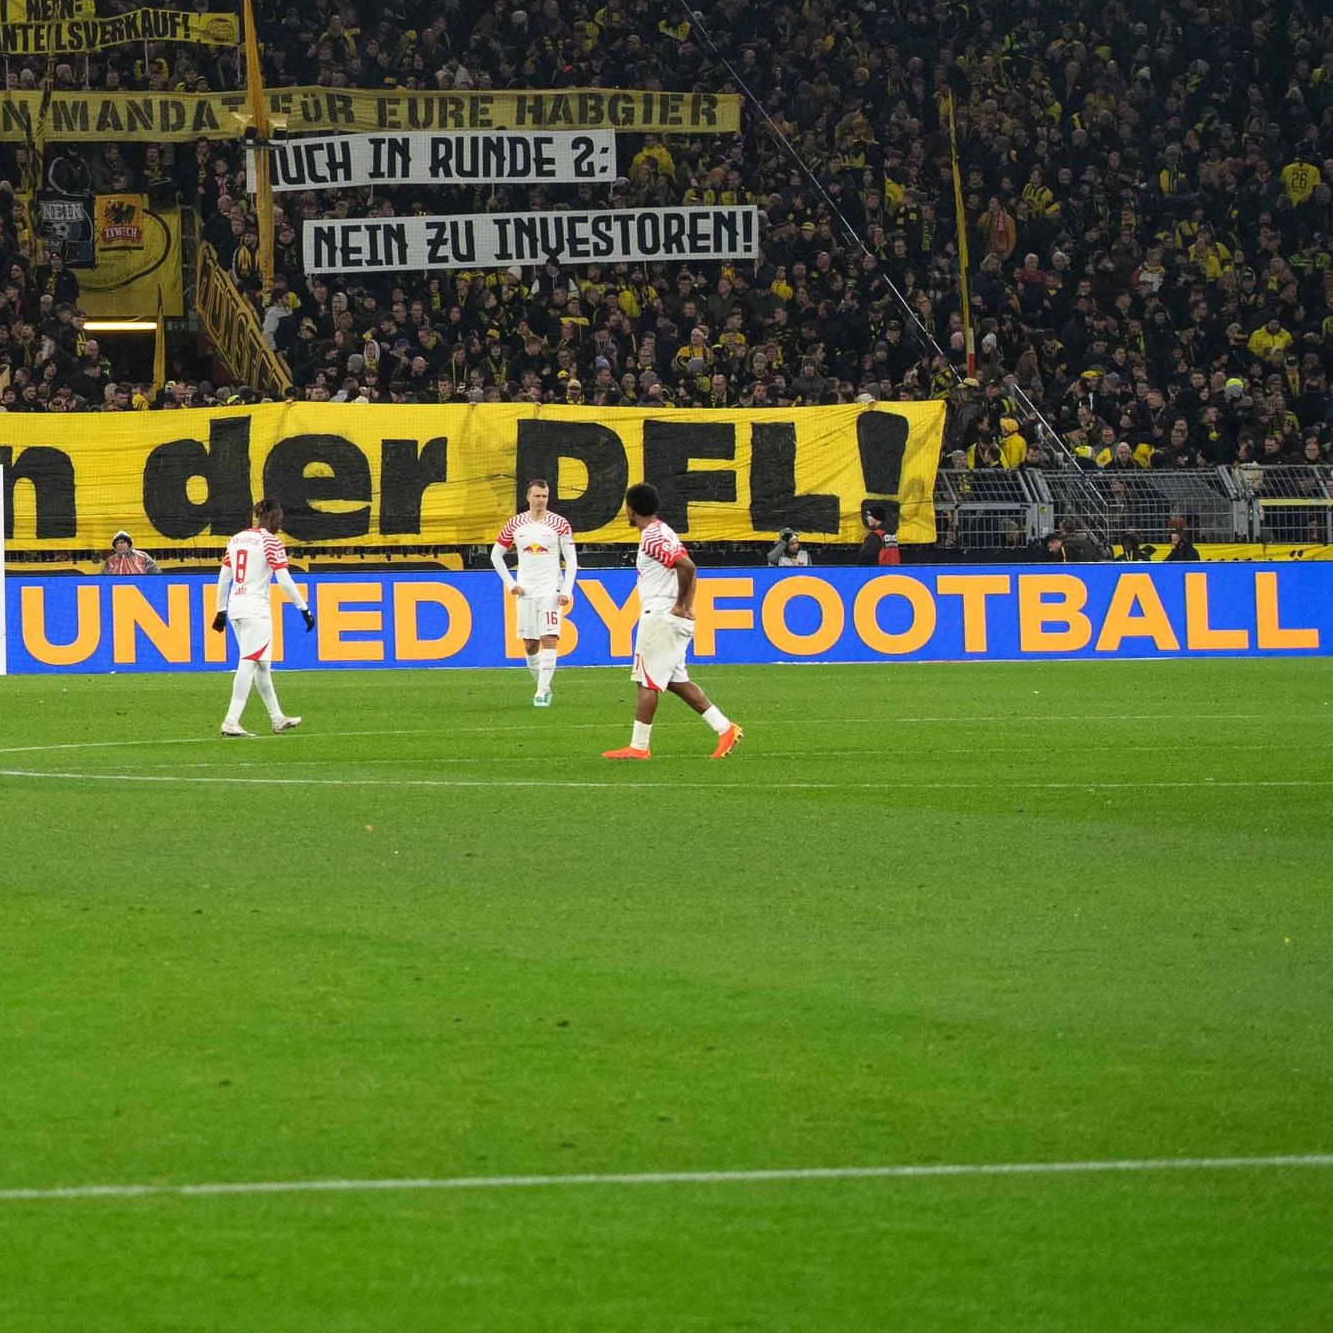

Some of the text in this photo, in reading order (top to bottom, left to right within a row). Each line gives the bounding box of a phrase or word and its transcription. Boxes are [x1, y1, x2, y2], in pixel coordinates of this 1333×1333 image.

[271, 92, 354, 124] FÜR
[376, 94, 494, 129] EURE
[515, 91, 718, 127] HABGIER
[271, 135, 611, 187] UCH IN RUNDE 2:
[40, 202, 84, 222] NEIN
[314, 211, 754, 268] NEIN ZU INVESTOREN!
[143, 415, 448, 543] der
[516, 410, 910, 536] DFL!
[235, 548, 249, 584] 8
[545, 611, 559, 627] 16
[691, 570, 1319, 657] FOOTBALL
